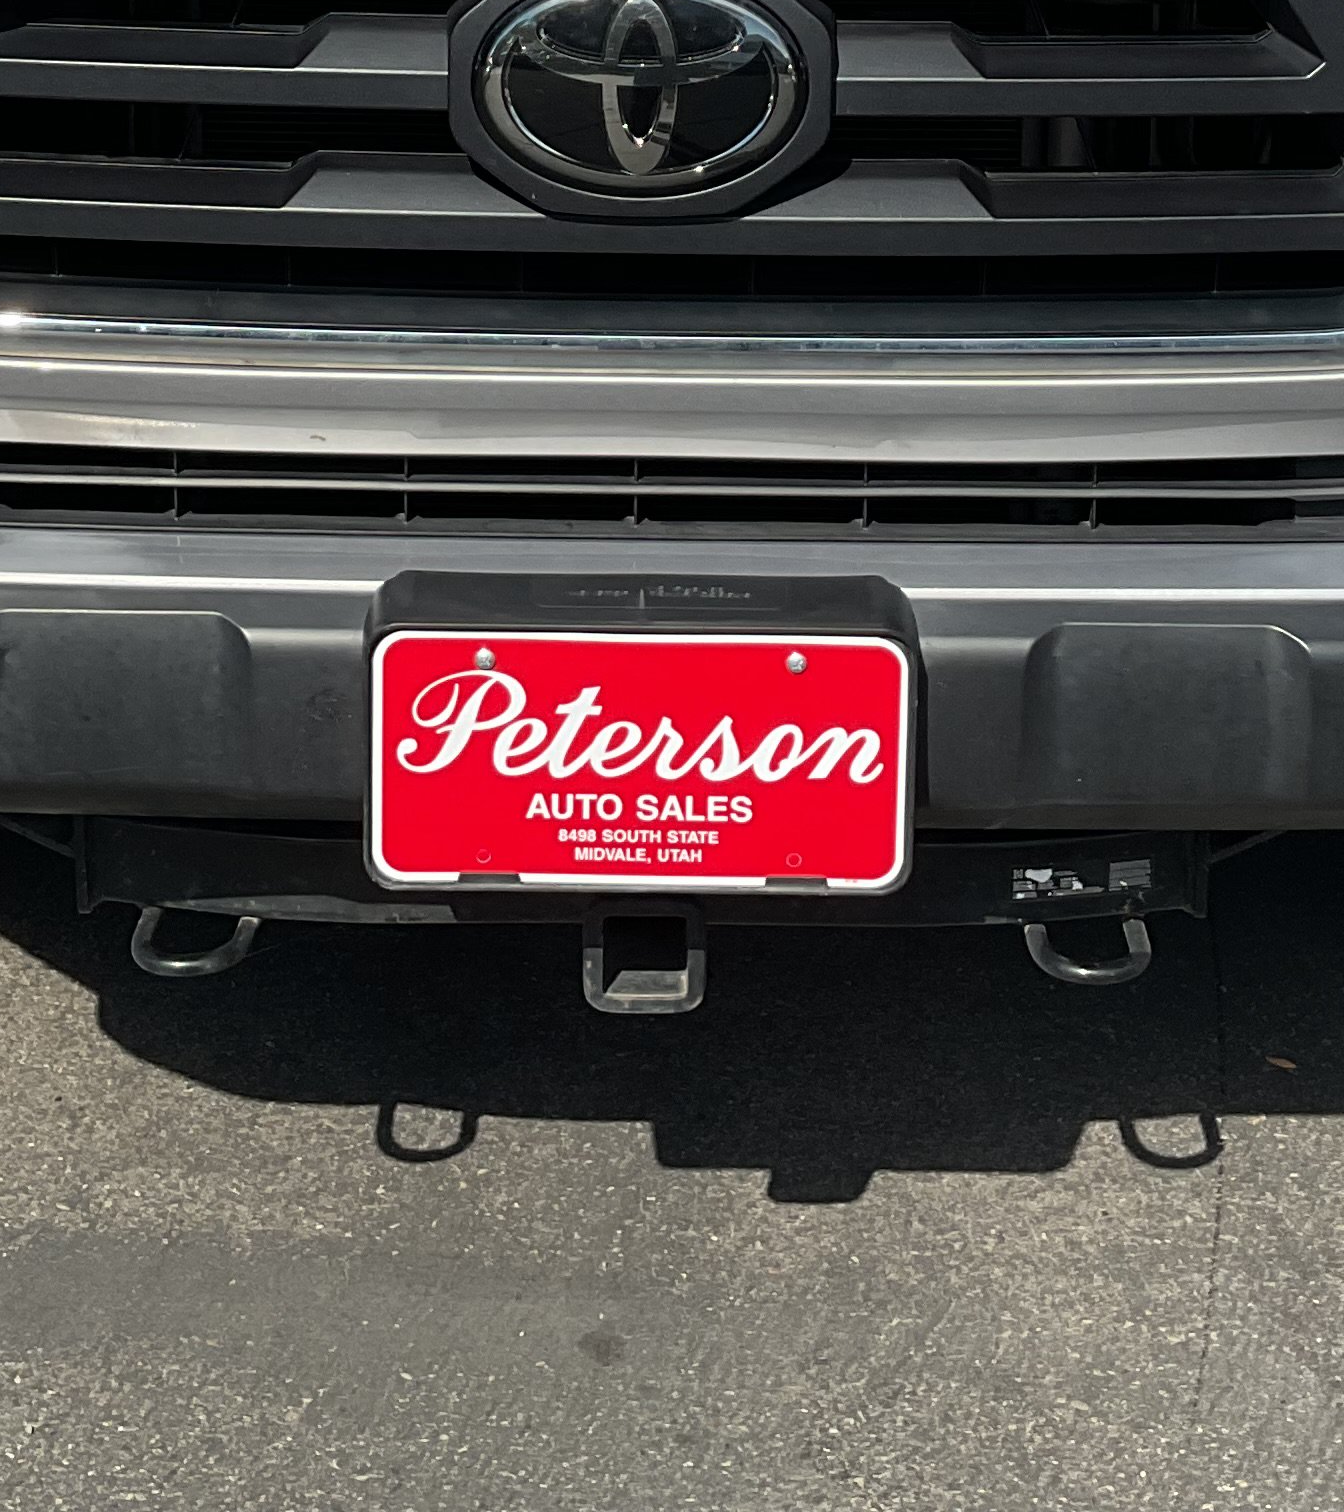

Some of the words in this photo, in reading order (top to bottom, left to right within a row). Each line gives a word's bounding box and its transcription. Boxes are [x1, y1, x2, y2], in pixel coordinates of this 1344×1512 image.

[394, 668, 885, 785] Peterson
[525, 792, 623, 822] AUTO
[634, 794, 754, 824] SALES
[557, 828, 597, 845] 8498
[600, 828, 662, 846] SOUTH
[664, 829, 720, 847] STATE
[573, 847, 653, 866] MIDVALE,
[656, 848, 703, 865] UTAH
